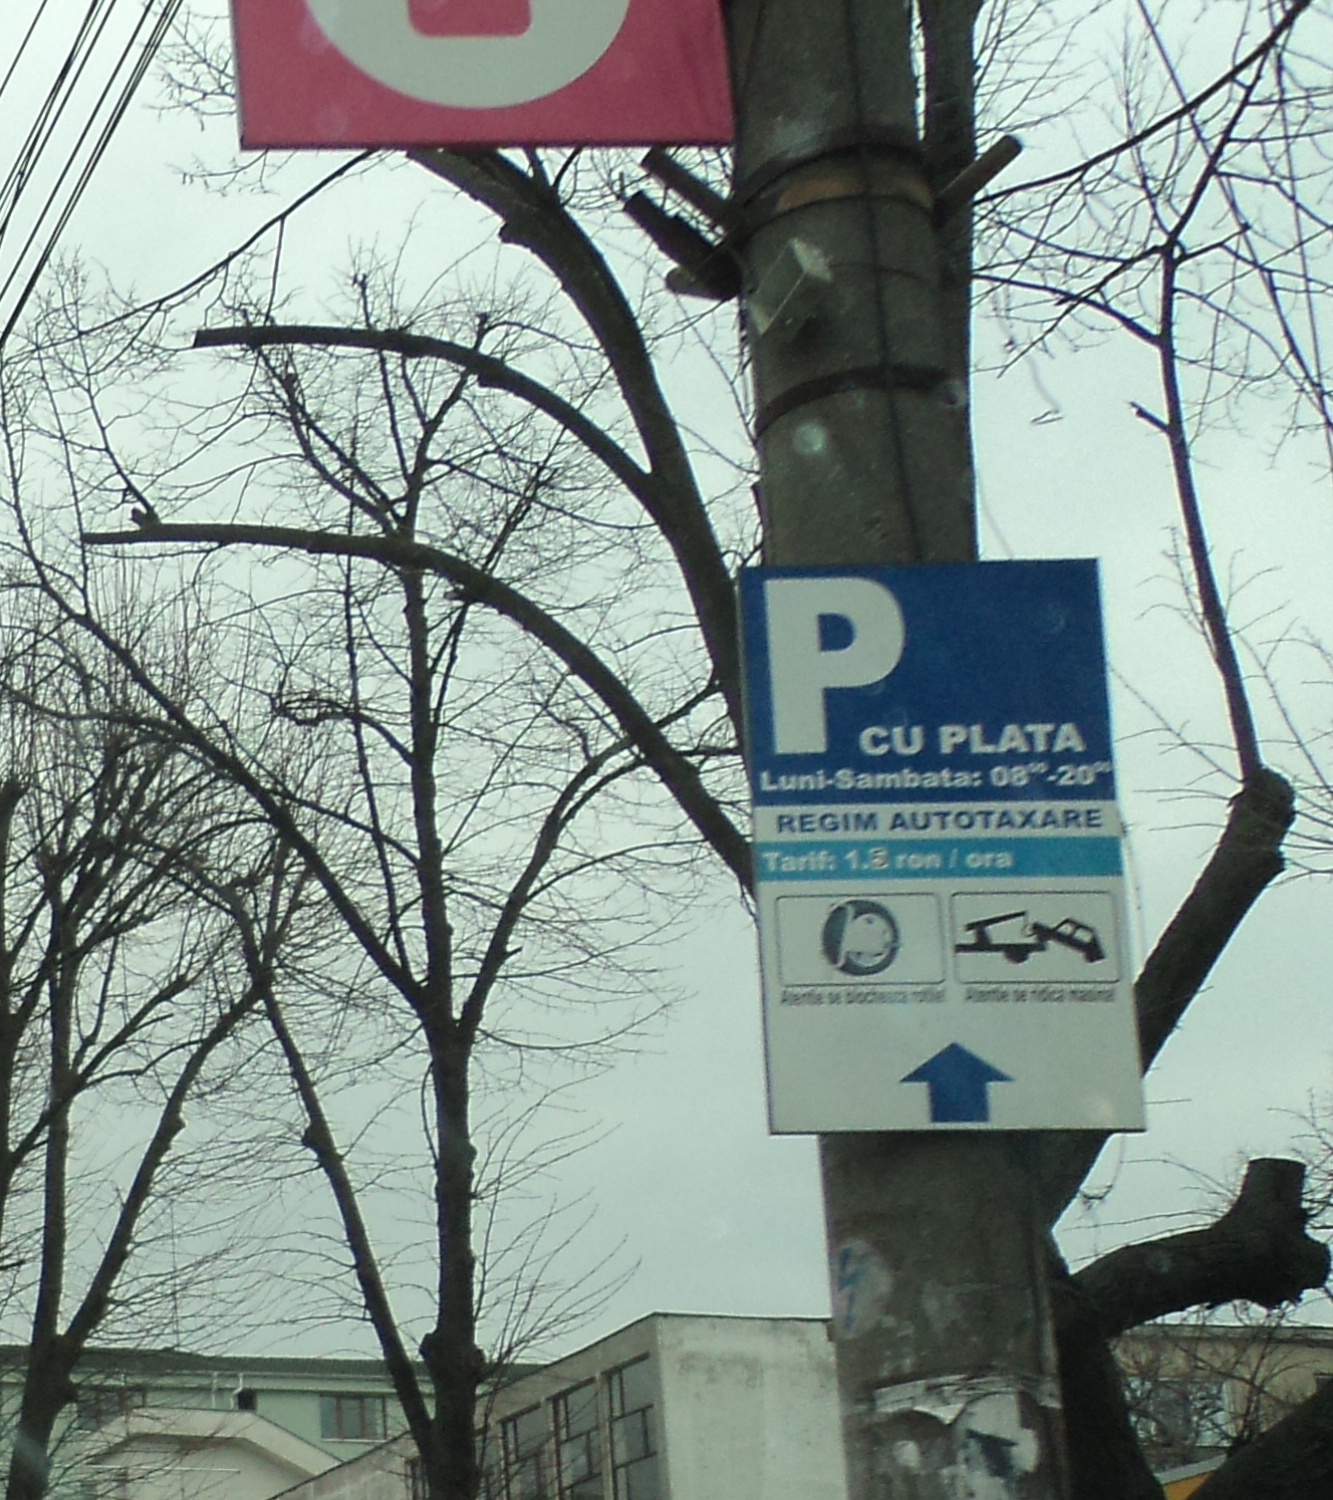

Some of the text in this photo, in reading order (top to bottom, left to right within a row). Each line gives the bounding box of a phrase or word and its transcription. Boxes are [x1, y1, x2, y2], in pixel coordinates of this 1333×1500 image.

[764, 577, 906, 755] P
[858, 721, 1088, 755] CU PLATA
[761, 767, 983, 790] Luni-Sambata:
[776, 809, 1104, 833] REGIM AUTOTAXARE
[762, 850, 838, 872] Tarif:
[895, 853, 943, 870] ron
[948, 848, 959, 869] /
[965, 851, 1015, 869] ora
